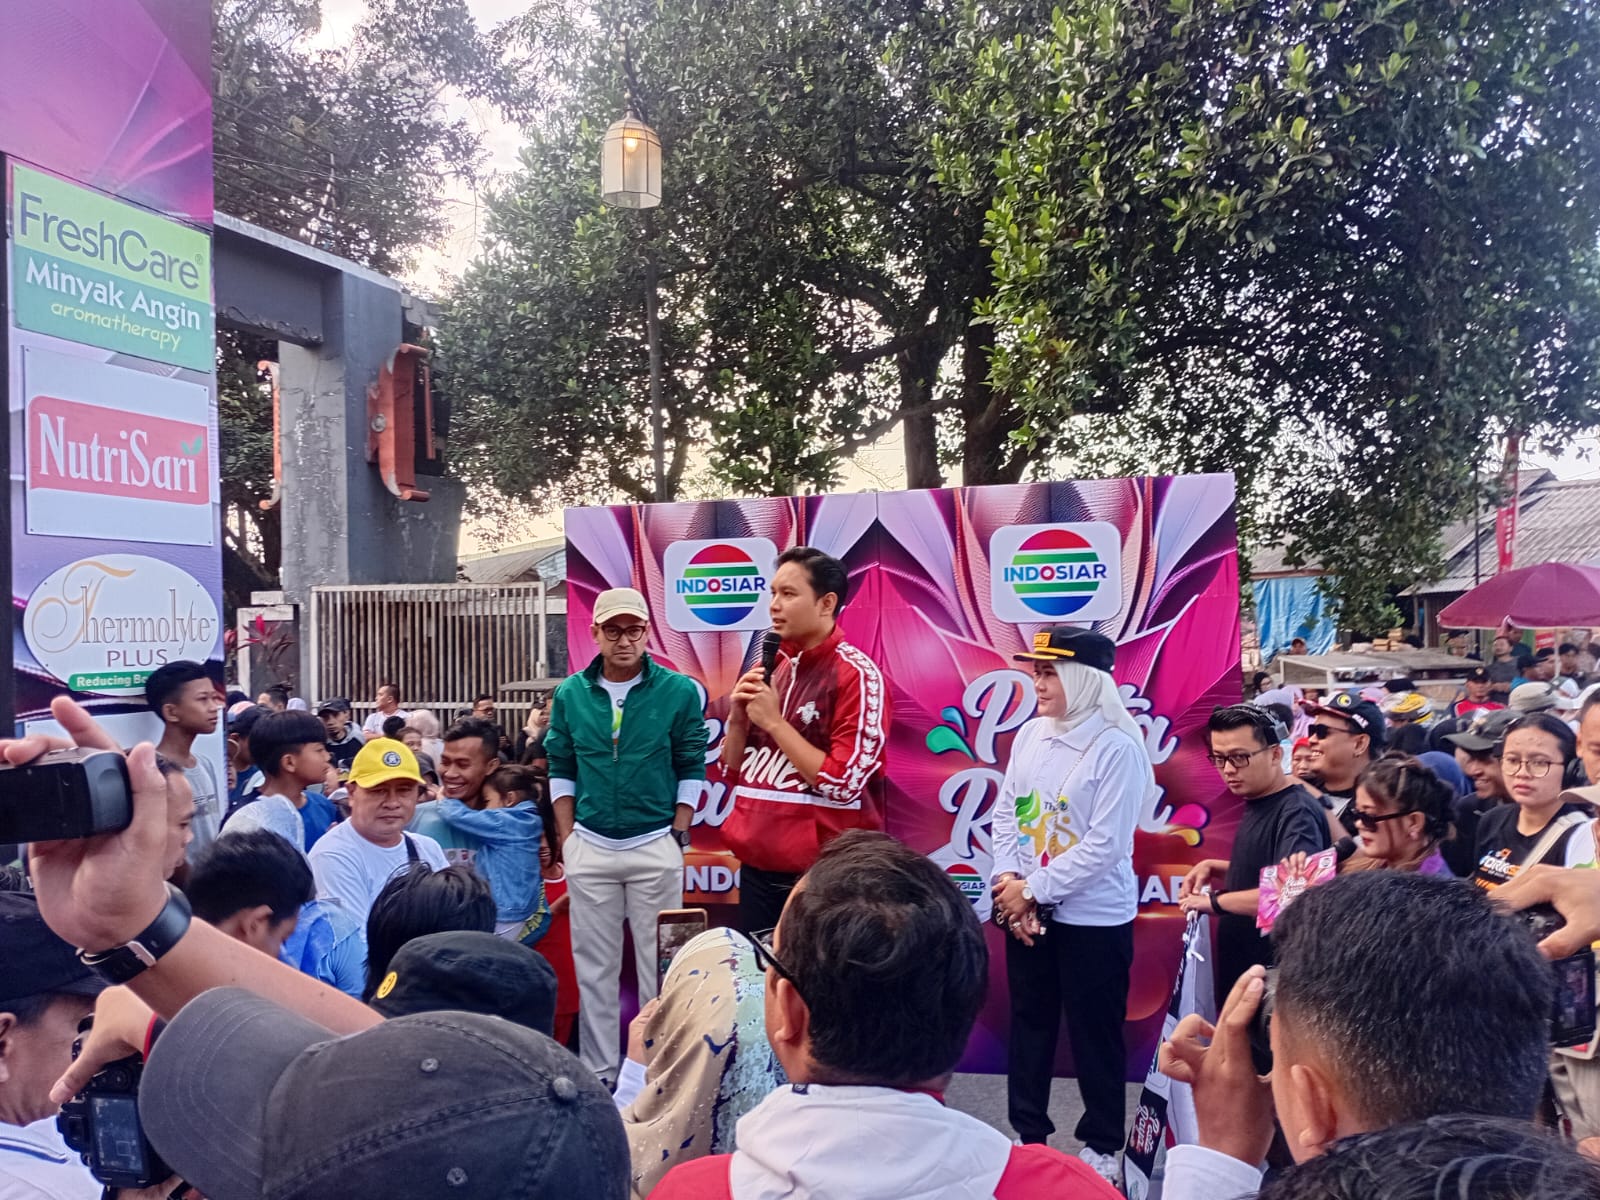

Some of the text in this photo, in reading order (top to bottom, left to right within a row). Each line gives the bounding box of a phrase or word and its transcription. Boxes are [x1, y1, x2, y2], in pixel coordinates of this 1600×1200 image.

[25, 257, 201, 330] Minyak Angin
[51, 302, 181, 352] aromatherapy
[38, 412, 198, 494] NutriSari
[675, 576, 766, 595] INDOSIAR
[1003, 562, 1108, 583] INDOSIAR
[32, 561, 210, 655] Thermolyte
[106, 648, 168, 667] PLUS
[77, 675, 132, 688] Reducing
